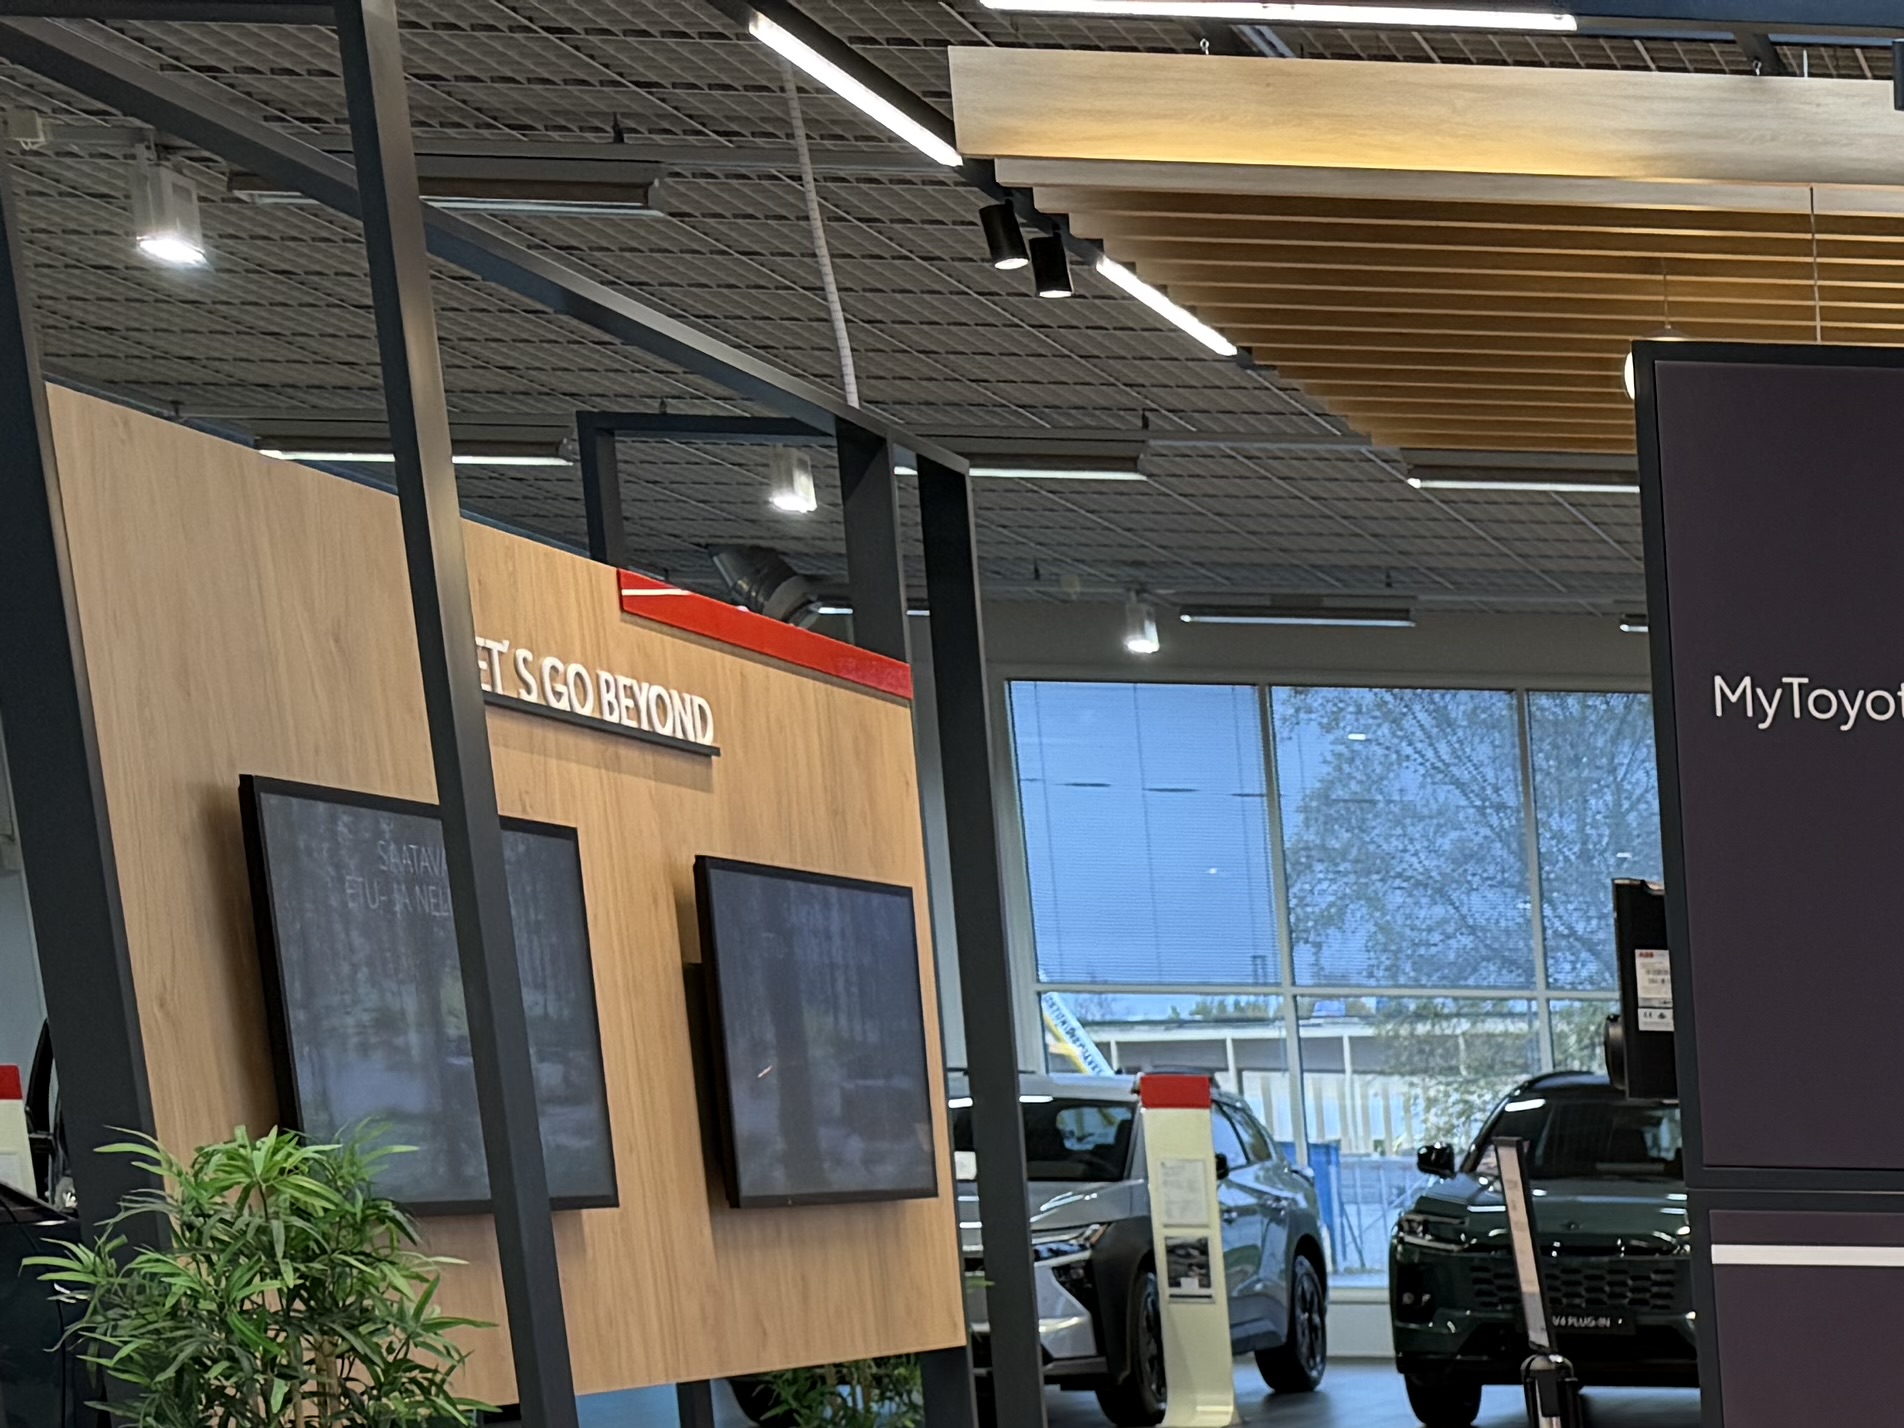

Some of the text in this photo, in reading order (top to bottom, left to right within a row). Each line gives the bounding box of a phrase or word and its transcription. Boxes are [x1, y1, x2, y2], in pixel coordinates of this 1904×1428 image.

[475, 637, 714, 746] ET'S GO BEYOND
